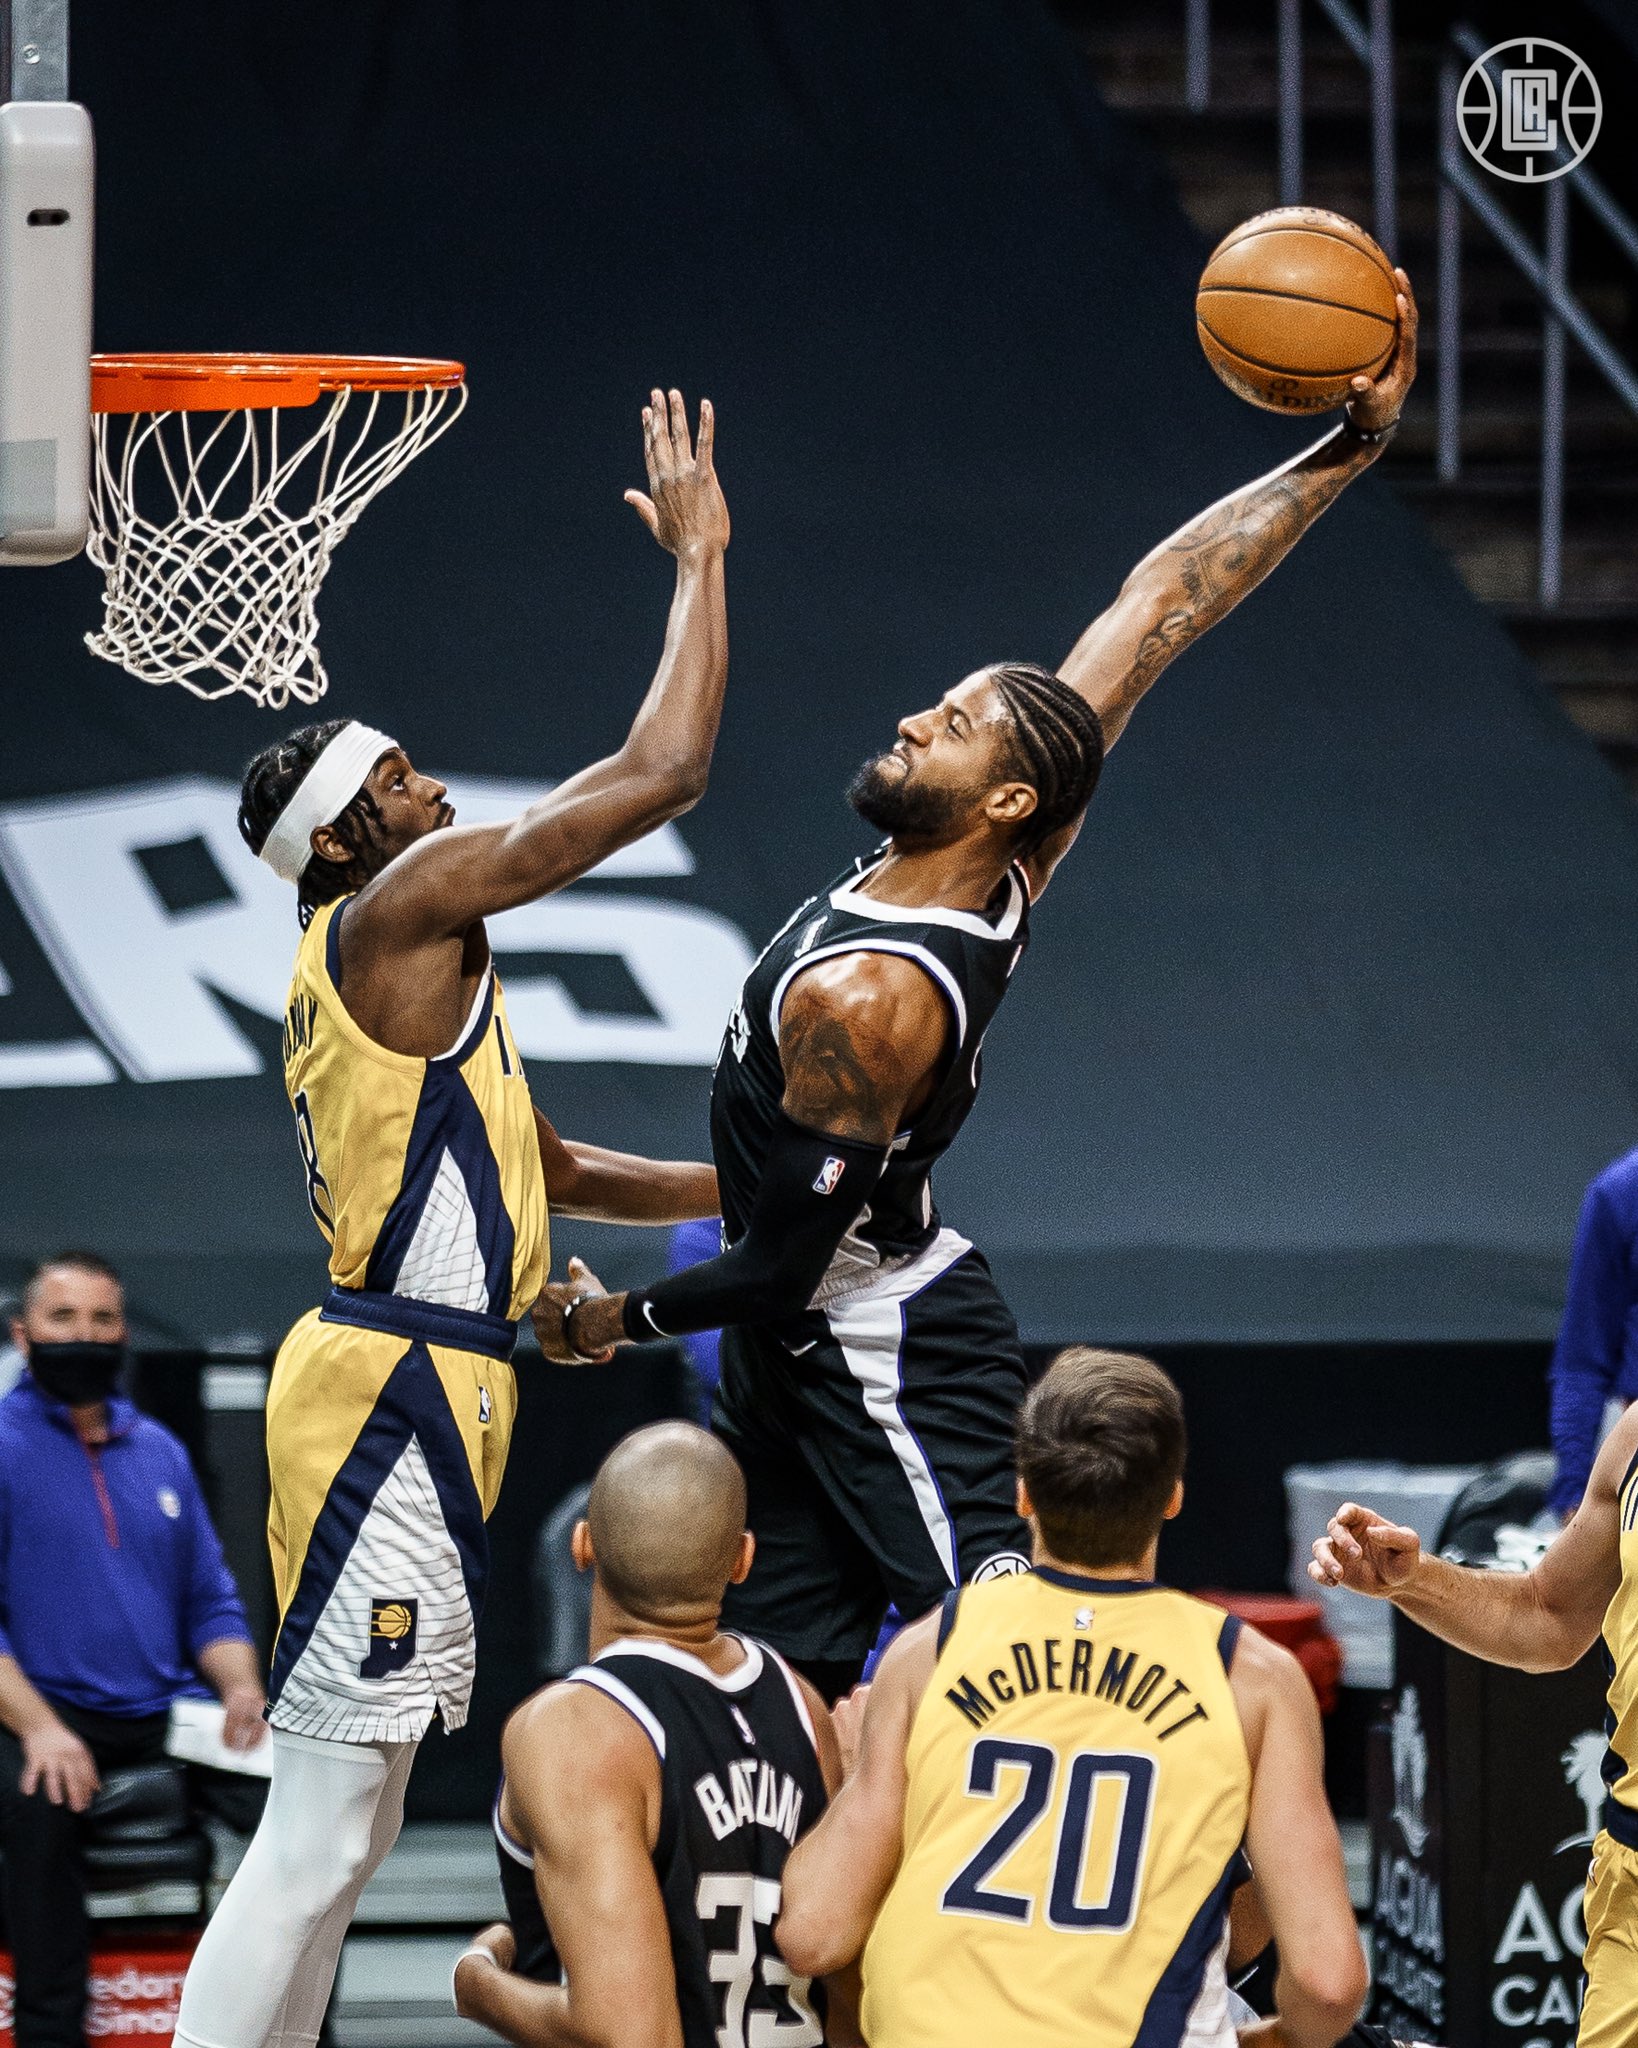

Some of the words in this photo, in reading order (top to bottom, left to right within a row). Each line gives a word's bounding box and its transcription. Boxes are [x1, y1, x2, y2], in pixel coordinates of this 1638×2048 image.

[0, 772, 754, 1088] RS
[944, 1638, 1210, 1742] McDERMOTT
[938, 1733, 1161, 1935] 20
